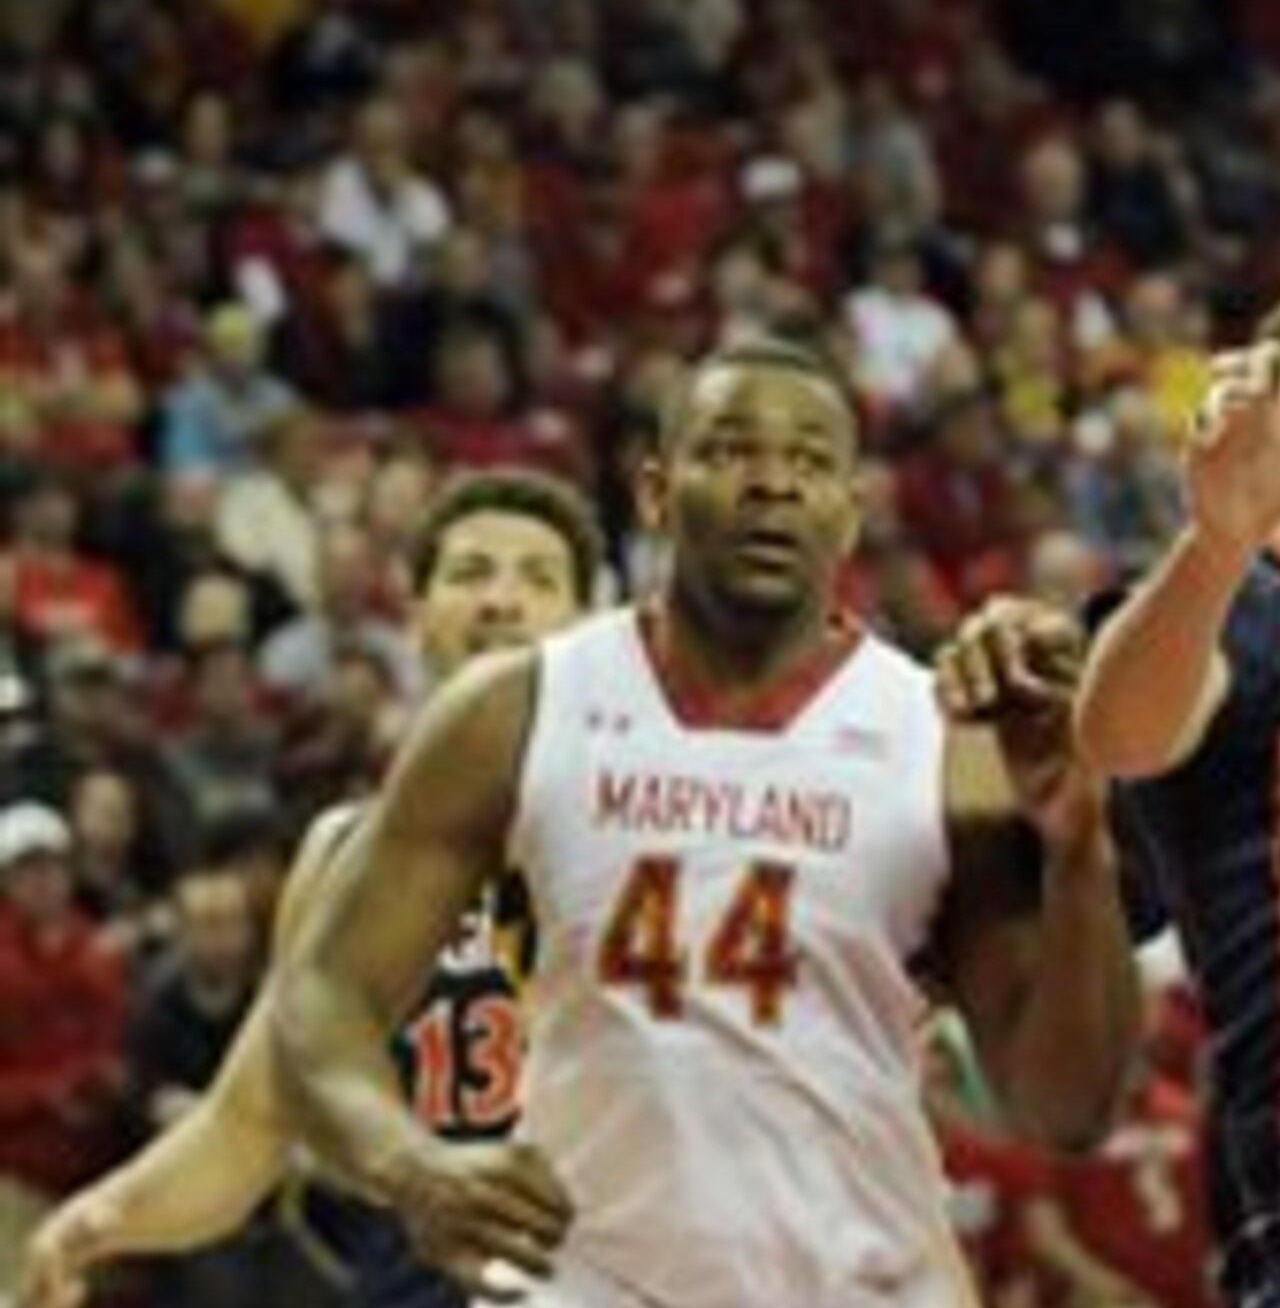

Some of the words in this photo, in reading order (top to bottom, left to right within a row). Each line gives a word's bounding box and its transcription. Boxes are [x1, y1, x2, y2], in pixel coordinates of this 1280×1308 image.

[597, 772, 851, 851] MARYLAND
[598, 855, 799, 1026] 44
[408, 997, 524, 1128] 13
